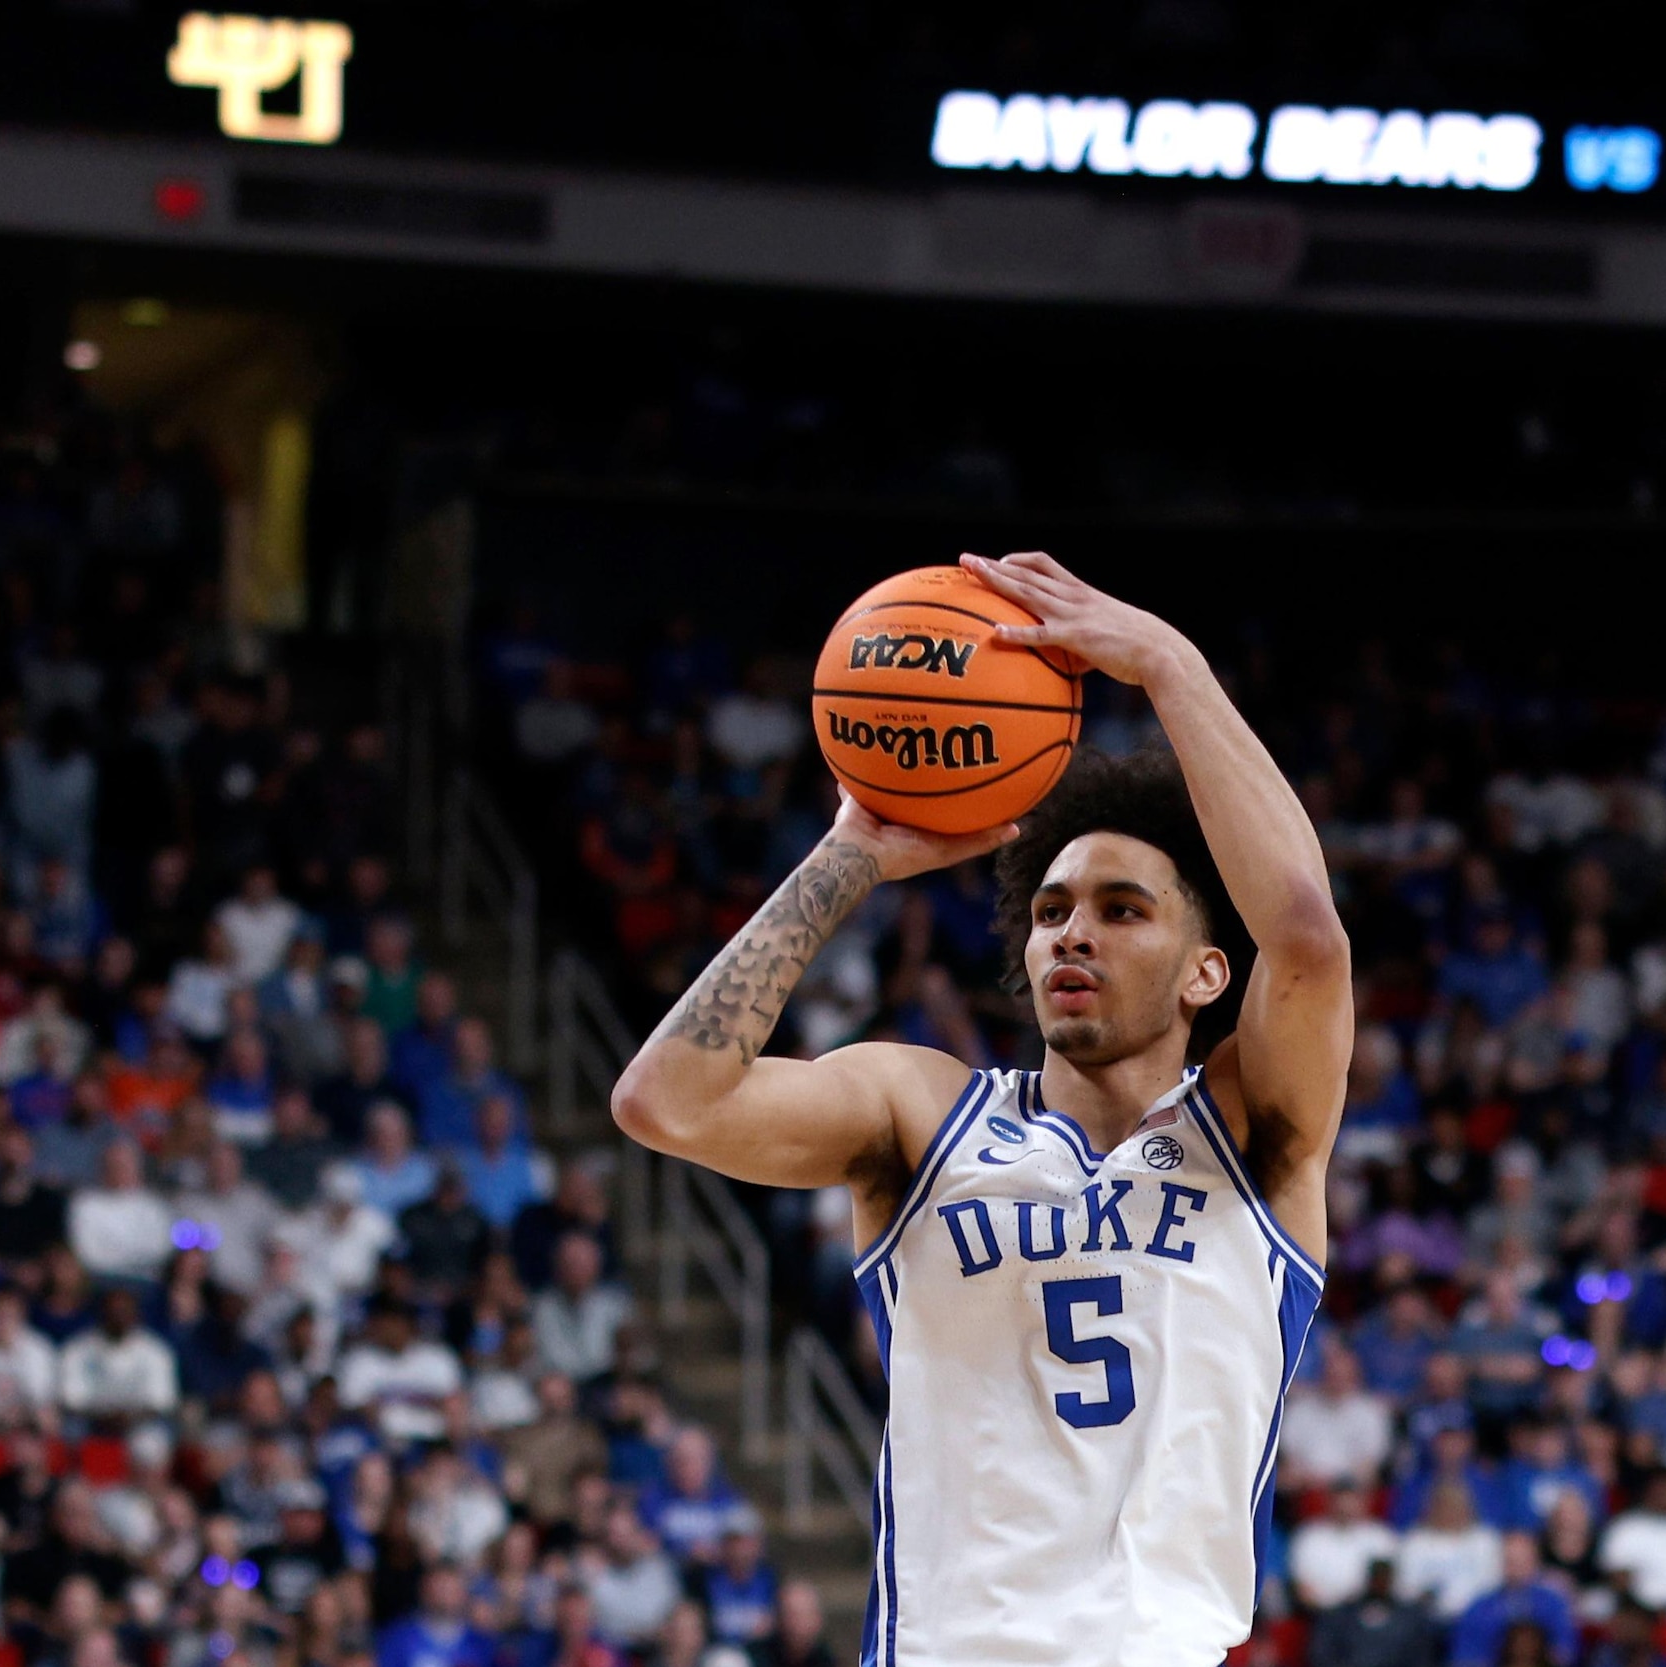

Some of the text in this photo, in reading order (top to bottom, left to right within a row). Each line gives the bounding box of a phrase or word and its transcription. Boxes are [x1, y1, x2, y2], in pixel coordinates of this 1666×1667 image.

[933, 91, 1256, 178] BAYLOR
[1264, 106, 1541, 190] BEARS
[848, 632, 977, 678] NCAA
[828, 710, 999, 771] Wilson
[990, 1121, 1024, 1143] NCAA
[937, 1180, 1208, 1277] DUKE
[1042, 1275, 1136, 1429] 5
